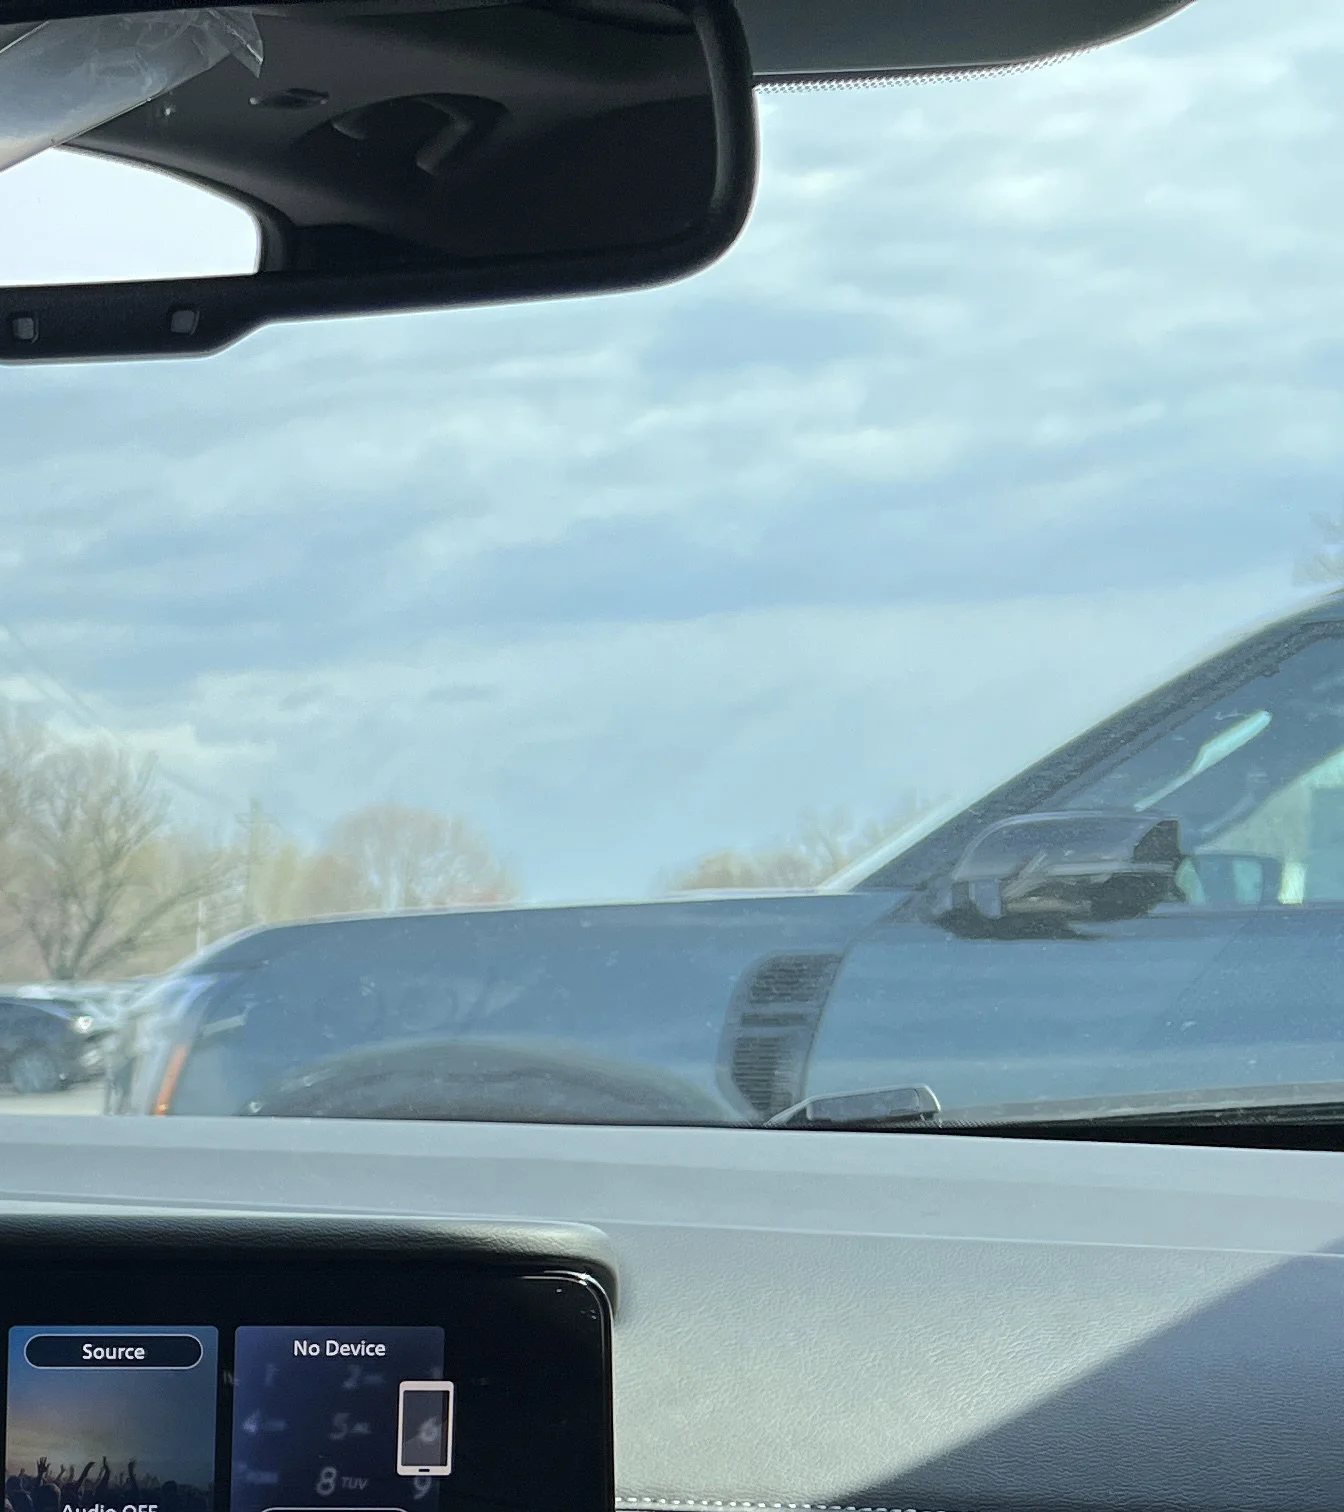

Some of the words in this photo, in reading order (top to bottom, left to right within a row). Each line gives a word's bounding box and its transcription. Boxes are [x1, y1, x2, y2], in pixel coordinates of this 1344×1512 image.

[81, 1343, 146, 1361] Source
[293, 1339, 320, 1357] No
[325, 1339, 386, 1357] Device
